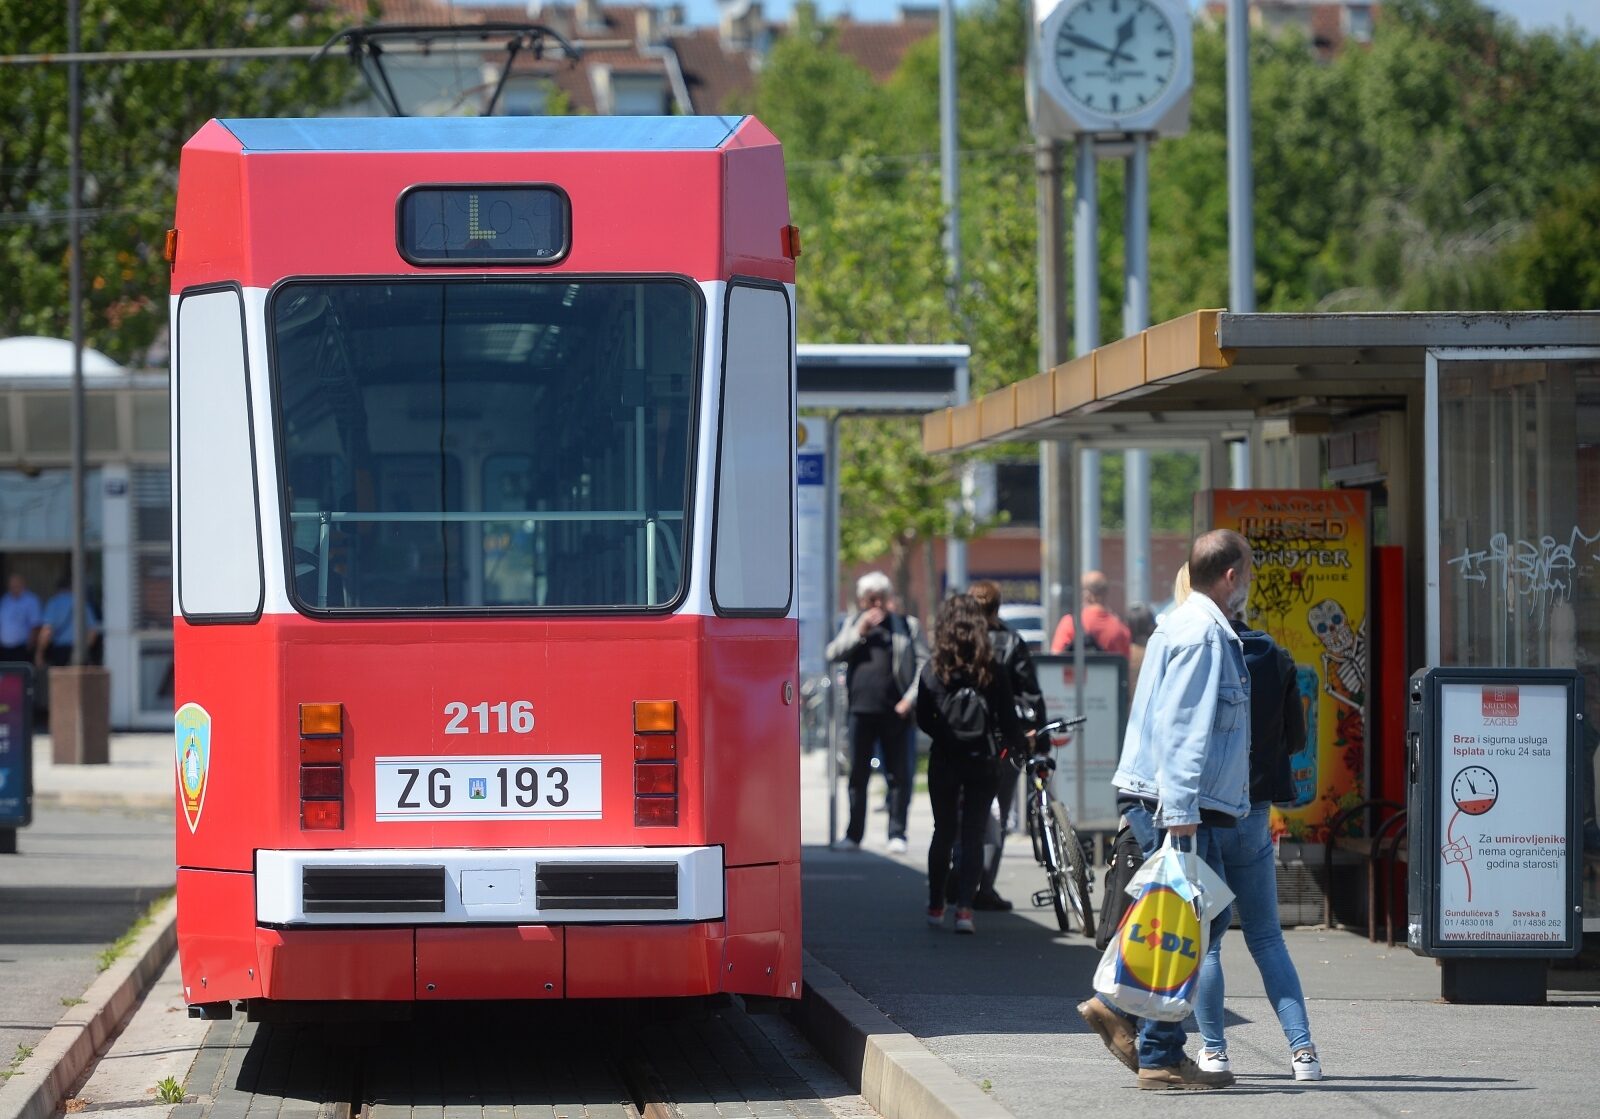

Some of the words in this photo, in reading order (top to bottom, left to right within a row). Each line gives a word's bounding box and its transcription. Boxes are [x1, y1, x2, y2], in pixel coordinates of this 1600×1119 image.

[469, 194, 497, 240] L
[1252, 548, 1353, 569] ONSTER
[444, 700, 535, 734] 2116
[1483, 718, 1518, 727] ZAGREB
[1453, 735, 1475, 744] Brza
[1518, 735, 1548, 746] usluga
[1453, 747, 1485, 757] Isplata
[1496, 747, 1516, 756] roku
[1518, 747, 1529, 756] 24
[1532, 748, 1551, 756] sata
[397, 767, 451, 808] ZG
[496, 767, 569, 808] 193
[1479, 834, 1492, 844] Za
[1495, 834, 1566, 846] umirovljenike
[1478, 848, 1506, 856] nema
[1509, 846, 1566, 858] ograničenja
[1486, 859, 1520, 870] godina
[1523, 859, 1558, 869] starosti
[1445, 909, 1493, 917] Gundulićeva
[1495, 909, 1500, 917] 5
